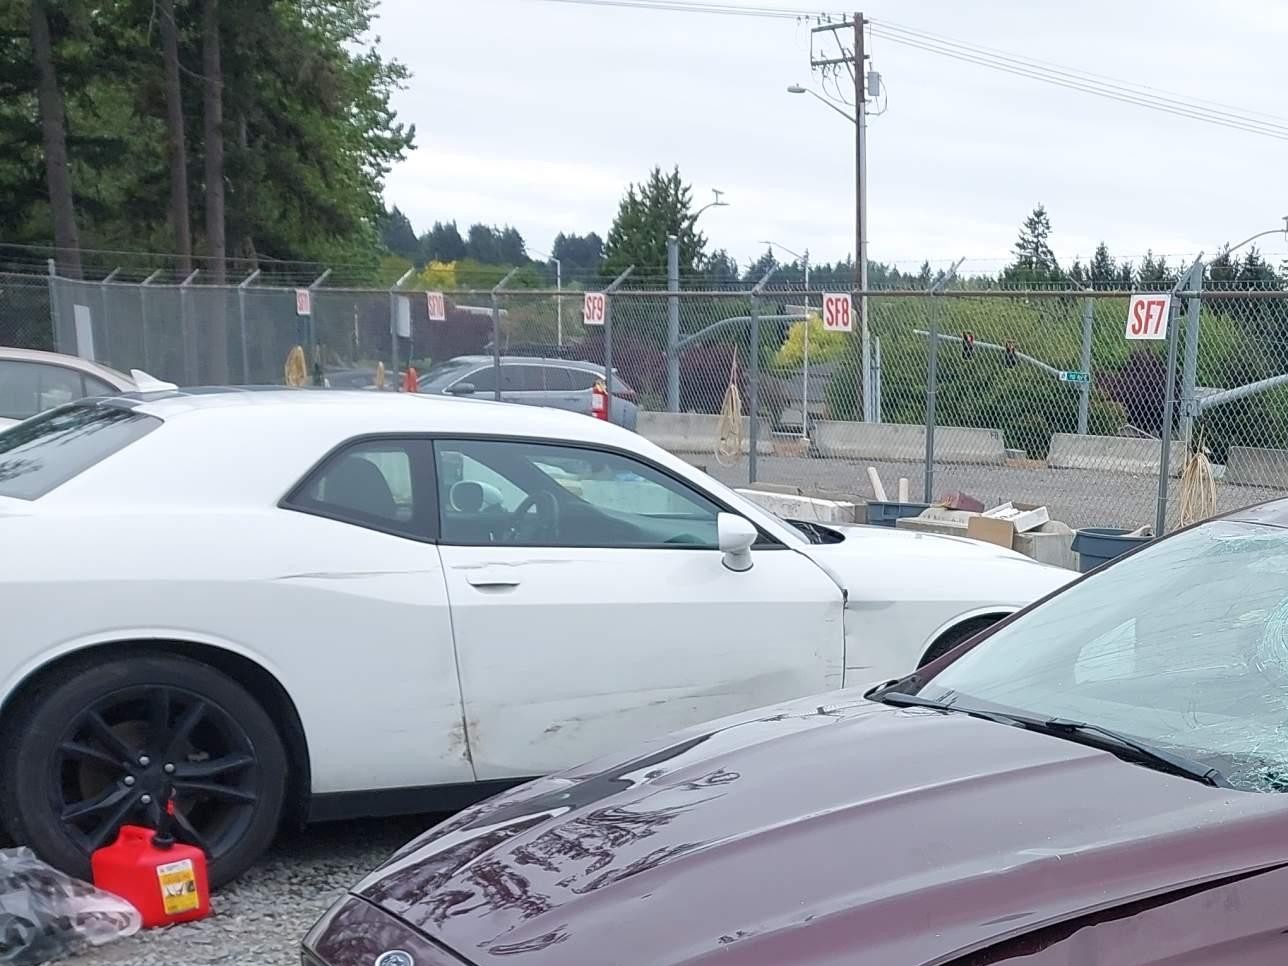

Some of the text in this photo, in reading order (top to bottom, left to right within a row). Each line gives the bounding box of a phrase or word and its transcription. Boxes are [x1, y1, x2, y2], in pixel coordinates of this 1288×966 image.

[586, 296, 603, 320] SF9
[827, 299, 849, 325] SF8
[1131, 299, 1165, 335] SF7
